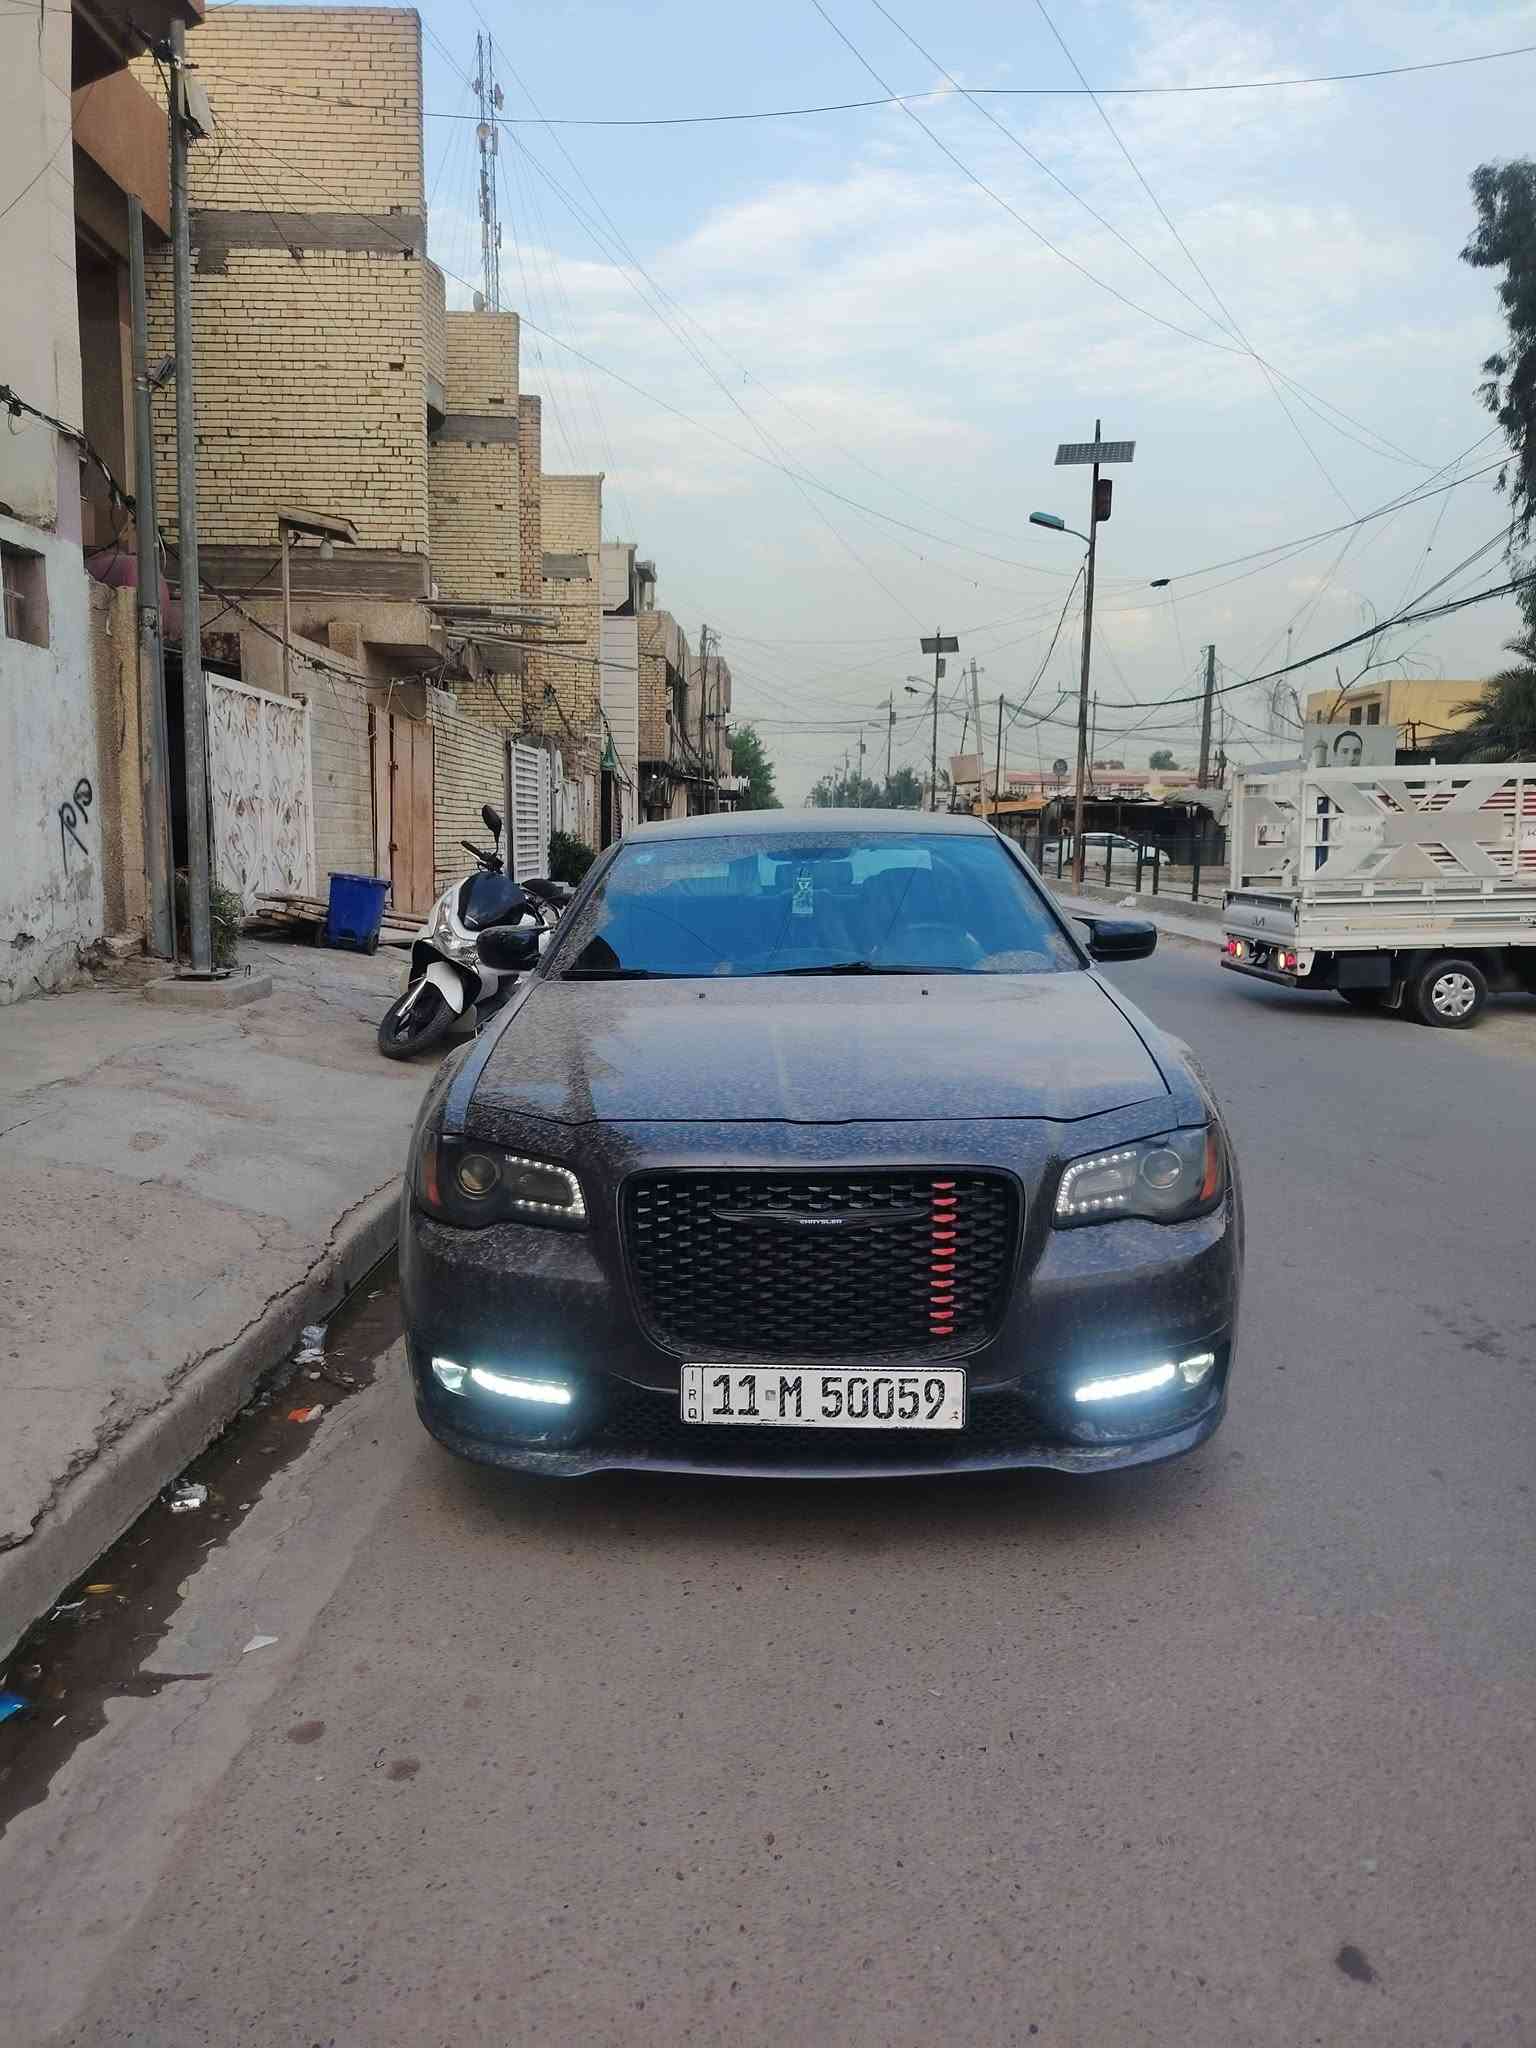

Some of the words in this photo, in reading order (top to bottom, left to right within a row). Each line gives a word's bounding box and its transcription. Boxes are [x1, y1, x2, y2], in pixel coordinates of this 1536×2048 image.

[688, 1369, 697, 1419] IRQ
[713, 1374, 759, 1416] 11
[779, 1375, 802, 1417] M
[821, 1376, 946, 1420] 50059
